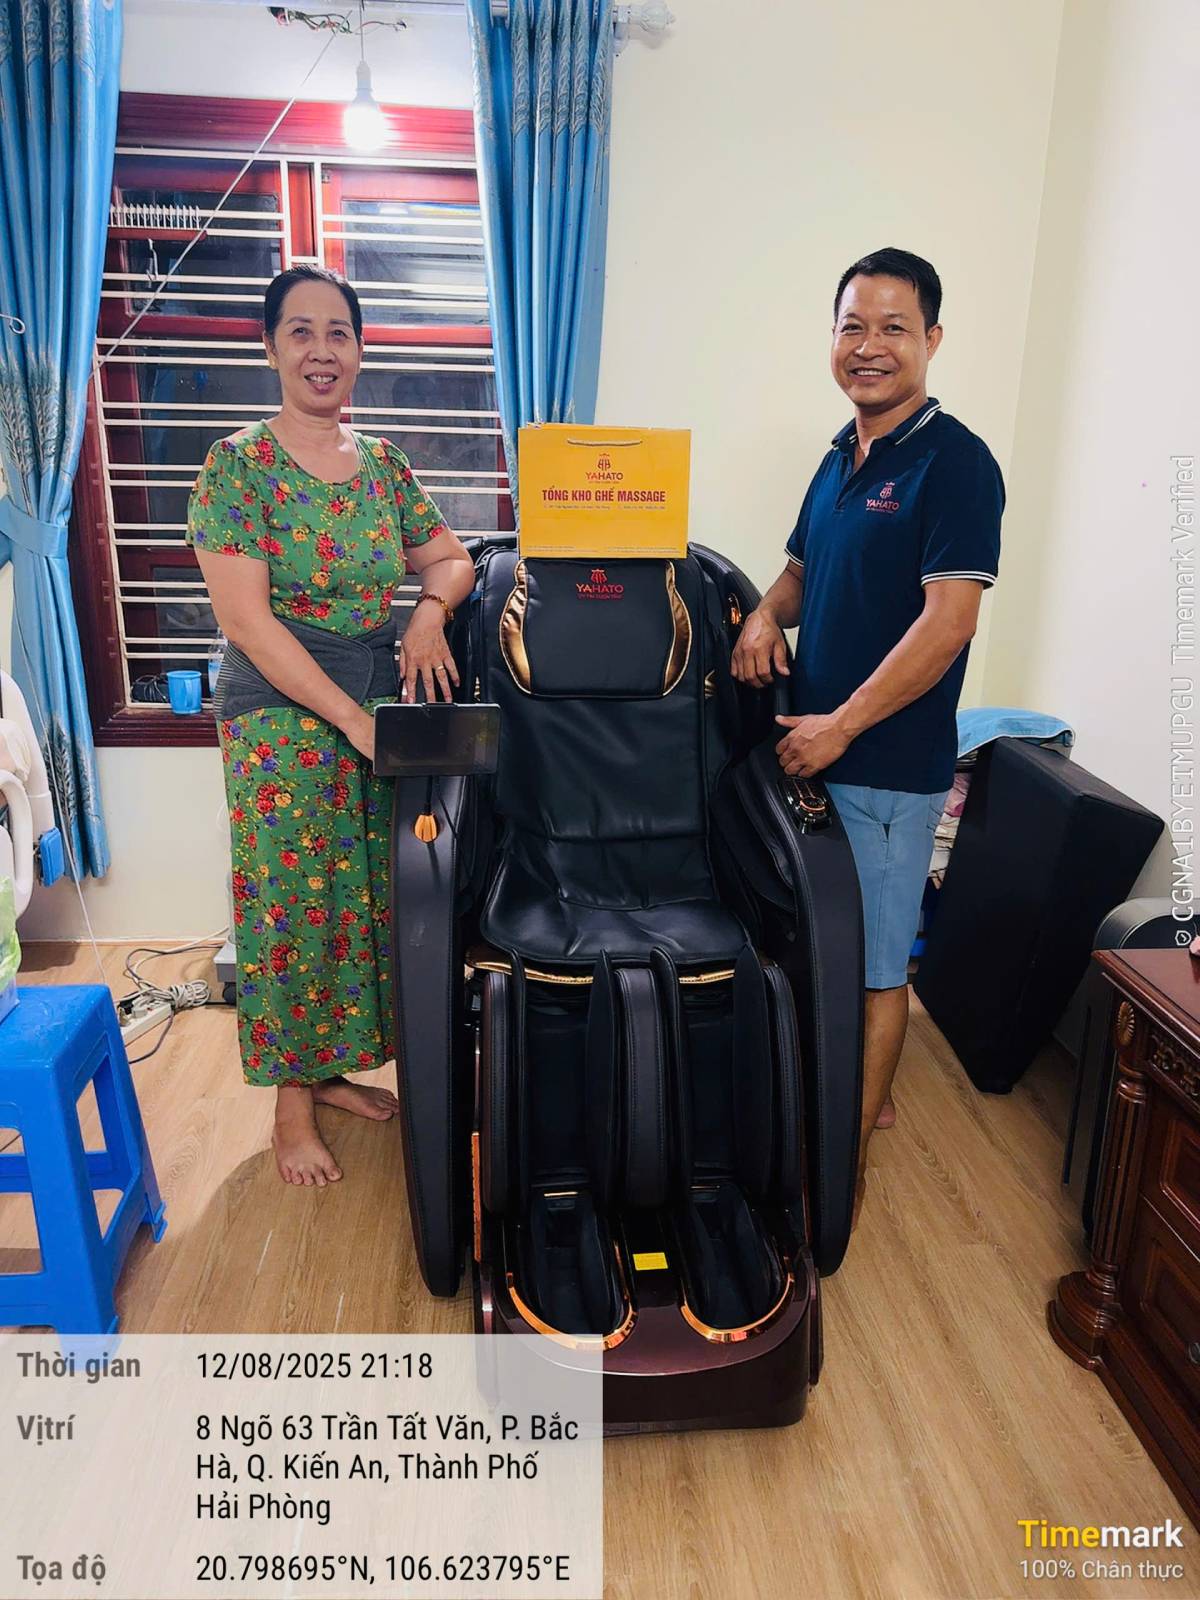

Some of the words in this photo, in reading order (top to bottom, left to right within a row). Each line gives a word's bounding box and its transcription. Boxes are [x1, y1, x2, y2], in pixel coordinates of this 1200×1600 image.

[585, 472, 624, 480] YAHATO
[542, 485, 569, 501] TỔNG
[571, 490, 592, 501] KHO
[595, 486, 614, 502] GHẾ
[617, 490, 666, 502] MASSAGE
[866, 499, 900, 511] YAHATO
[576, 583, 624, 593] YAHATO
